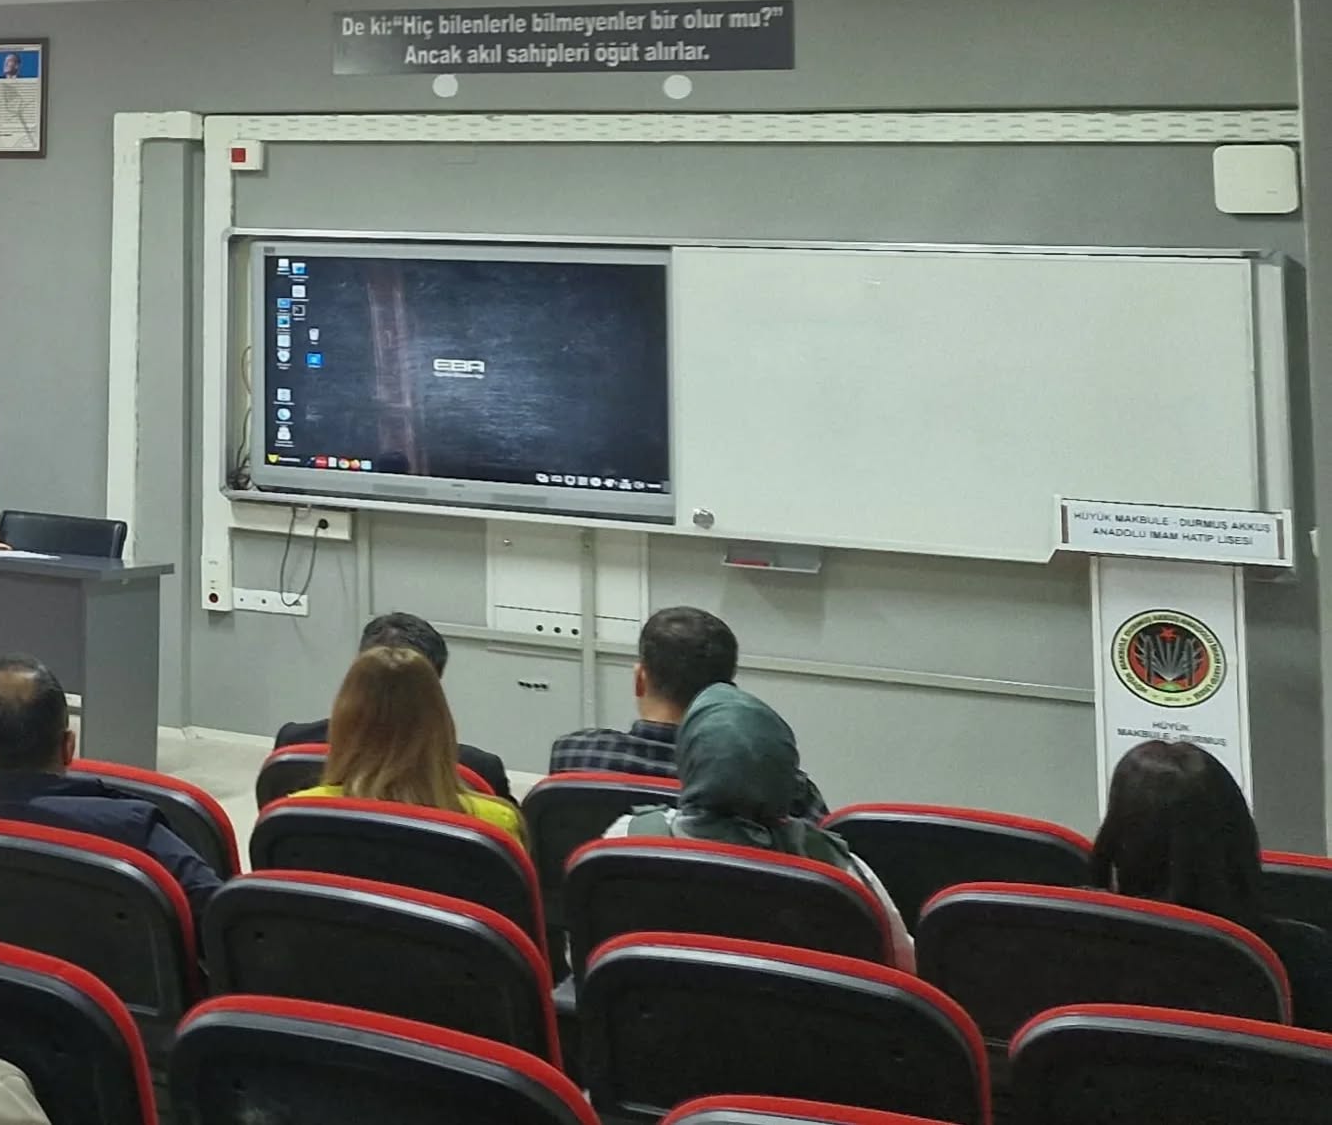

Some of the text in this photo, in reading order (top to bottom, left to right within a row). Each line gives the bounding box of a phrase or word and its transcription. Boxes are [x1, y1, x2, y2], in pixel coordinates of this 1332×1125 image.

[342, 17, 365, 36] De
[439, 13, 526, 34] bilenlerle
[532, 10, 646, 36] bilmeyenler
[650, 9, 678, 30] bir
[683, 8, 724, 29] olur
[404, 40, 710, 68] Ancak akıl sahipleri öğüt alırlar.
[433, 358, 485, 373] EBA
[1115, 514, 1169, 526] MAKBULE
[1093, 527, 1146, 538] ANADOLU
